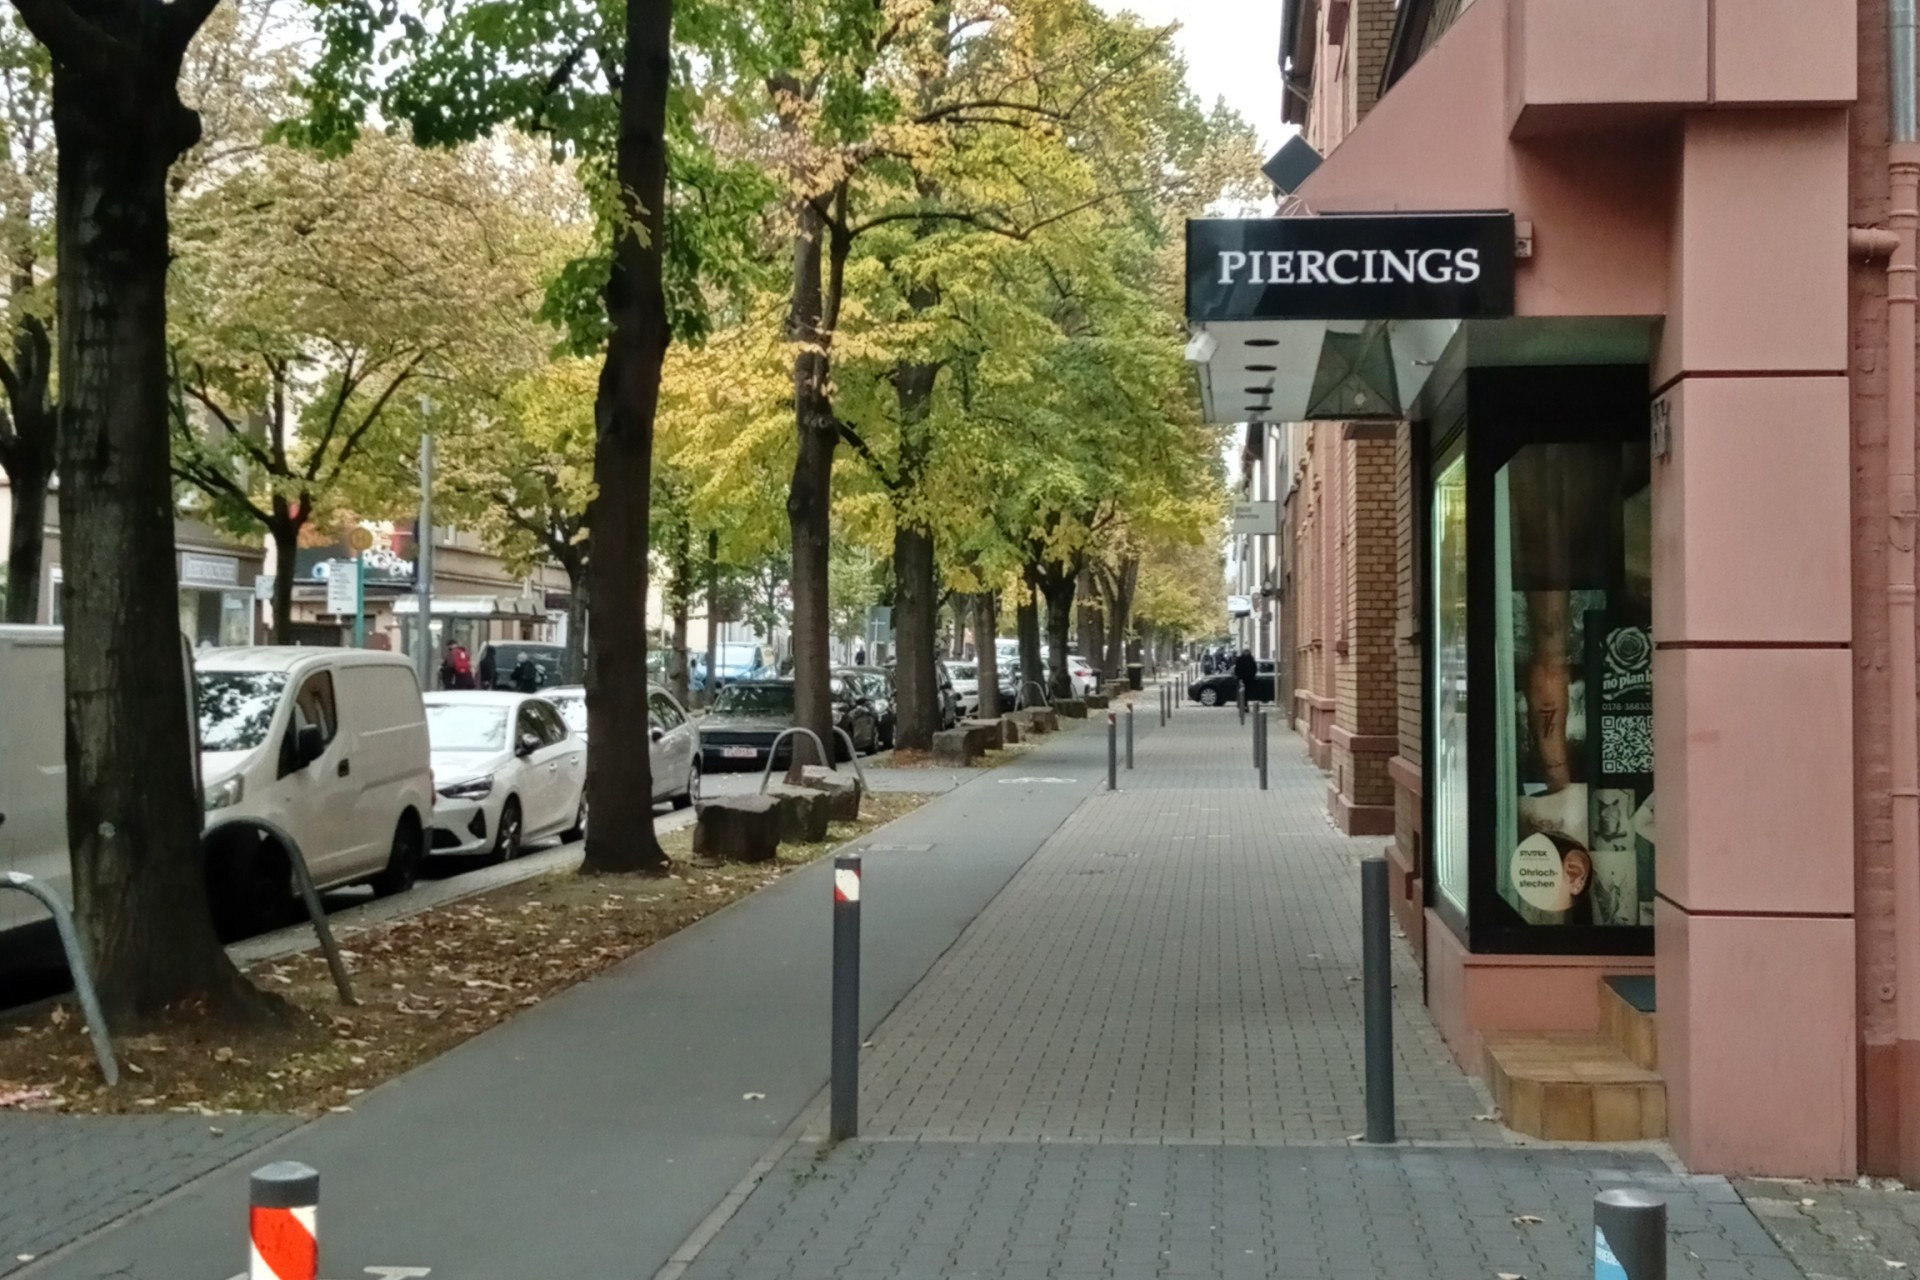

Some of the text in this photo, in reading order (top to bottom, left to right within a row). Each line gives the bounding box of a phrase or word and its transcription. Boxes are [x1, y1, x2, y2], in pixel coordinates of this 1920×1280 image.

[1218, 248, 1481, 285] PIERCINGS
[1603, 678, 1618, 690] no
[1619, 672, 1645, 690] plan
[1519, 868, 1558, 876] Ohrloch-
